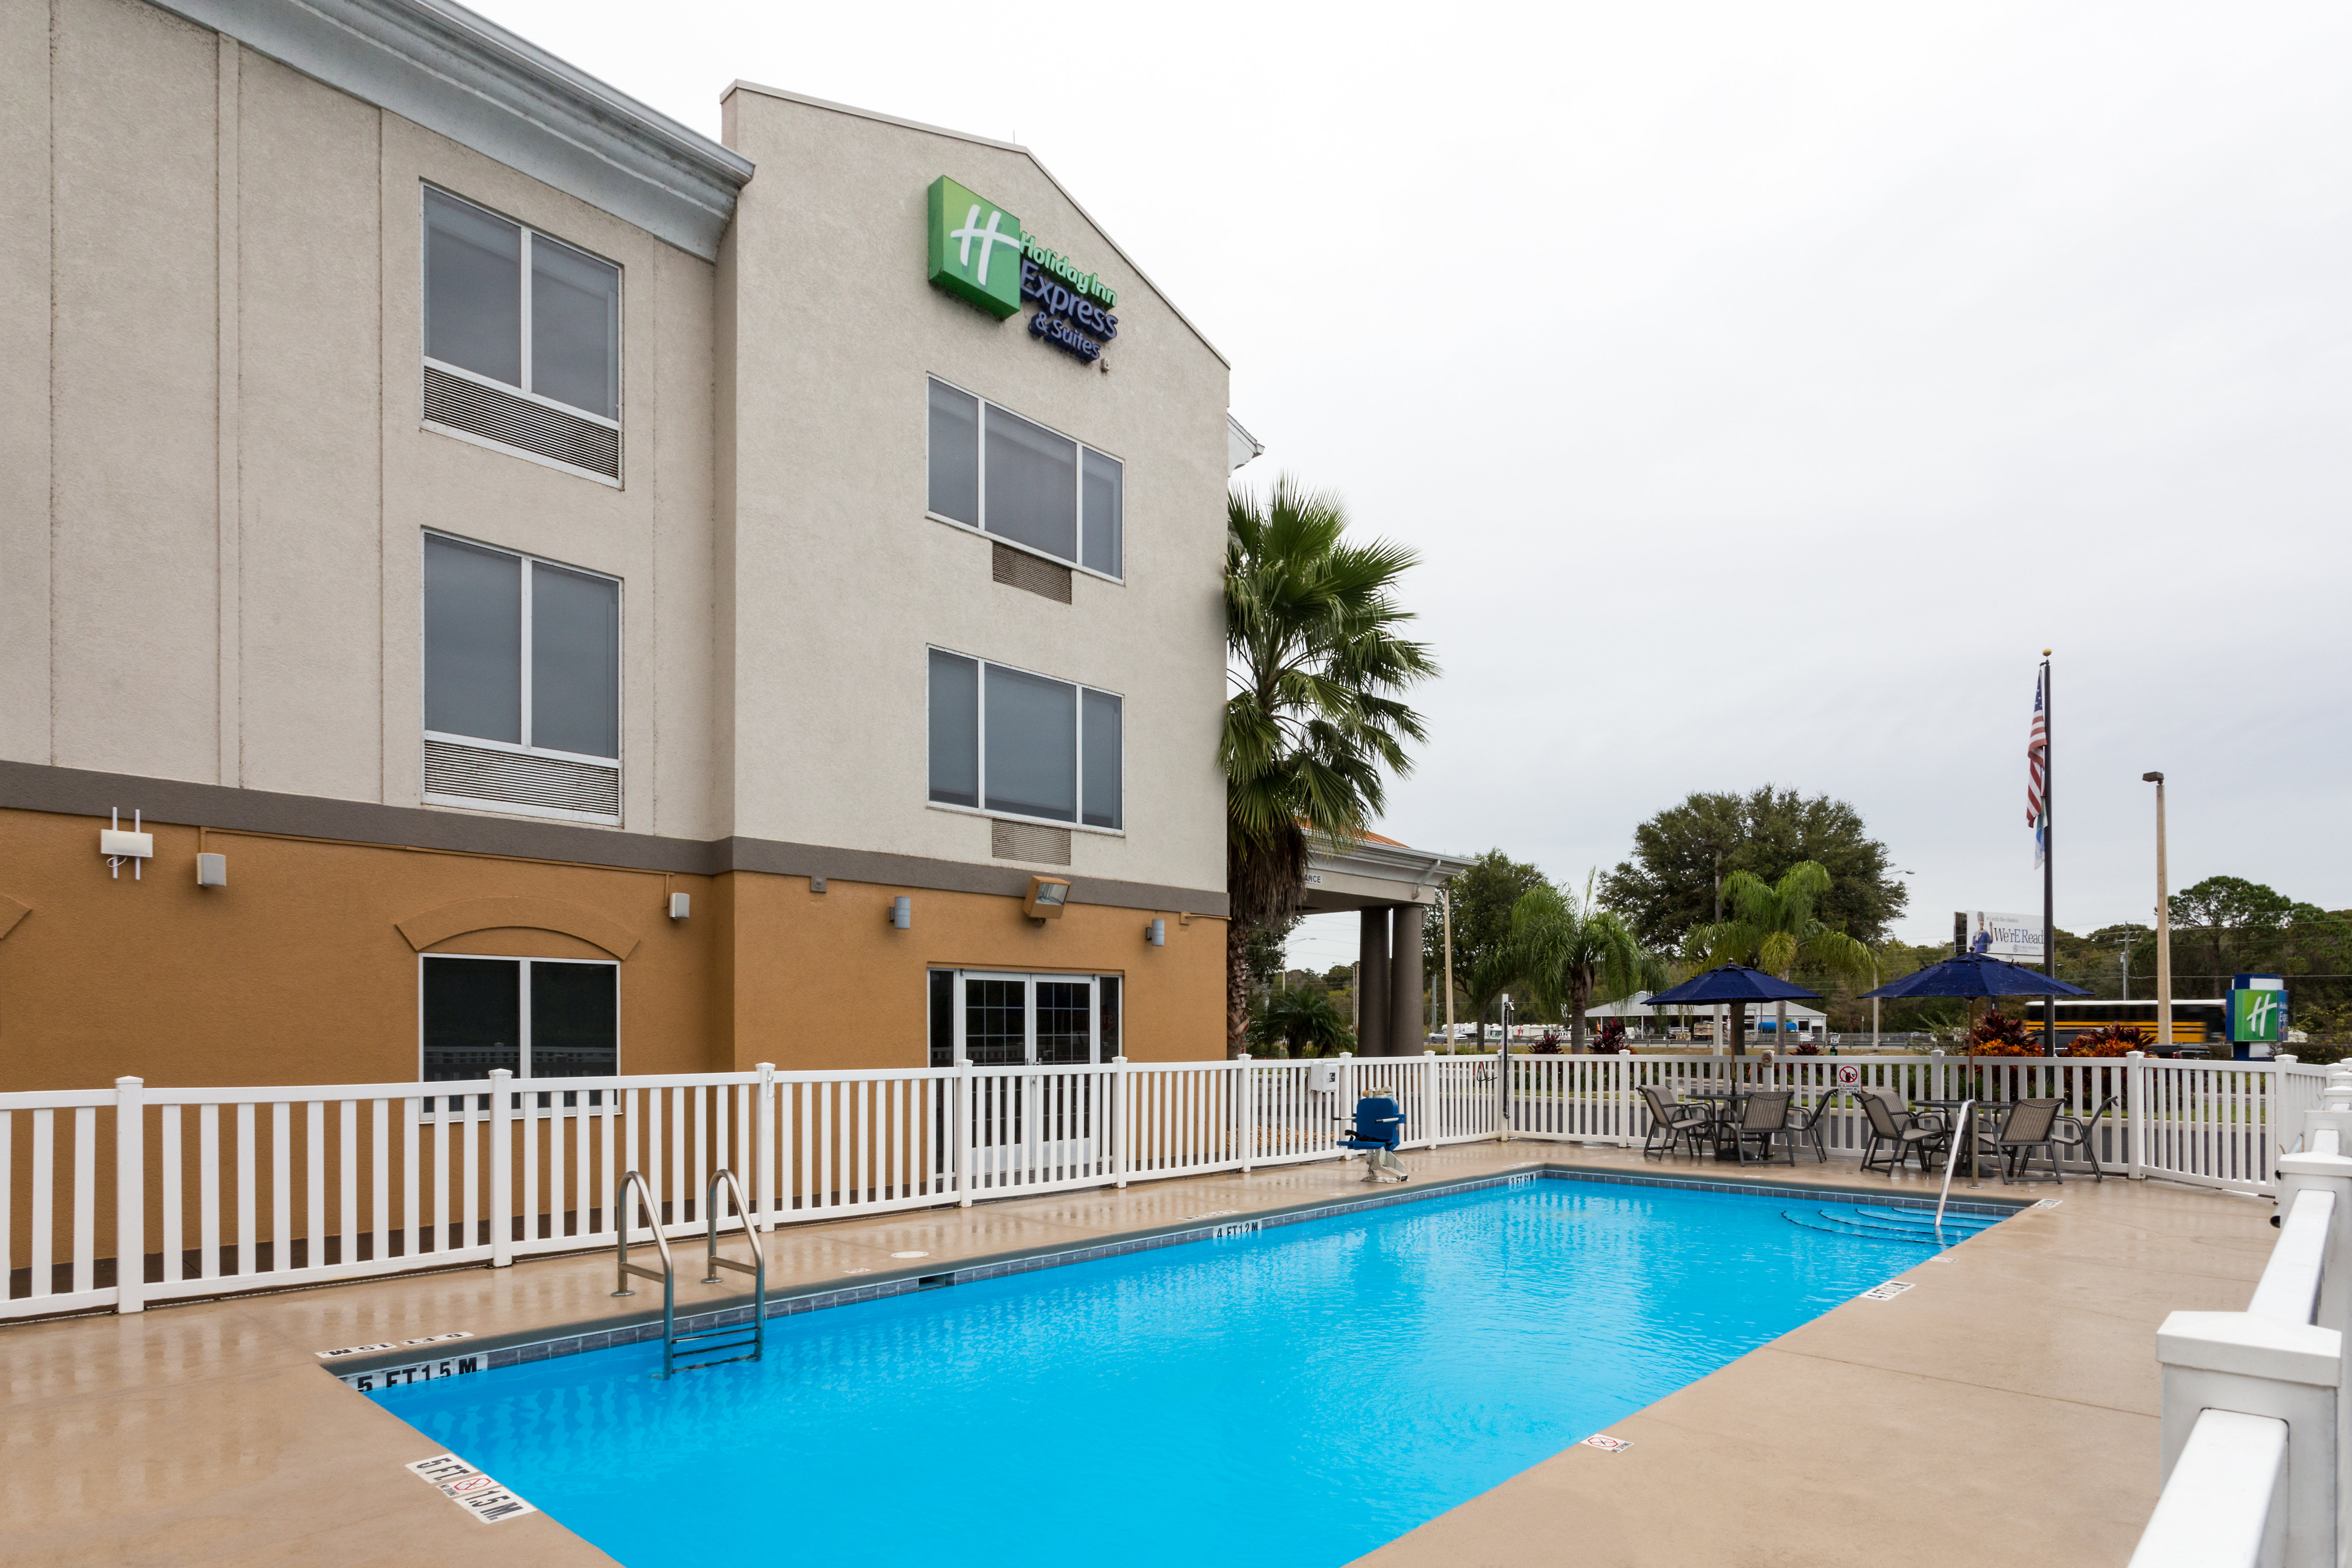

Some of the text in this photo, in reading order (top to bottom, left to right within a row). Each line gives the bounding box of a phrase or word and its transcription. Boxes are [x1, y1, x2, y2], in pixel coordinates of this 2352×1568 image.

[1020, 230, 1118, 307] Holiday Inn
[1020, 259, 1118, 339] Express
[1036, 311, 1100, 359] & Suites
[1305, 874, 1321, 883] ANCE
[2022, 929, 2044, 944] Read
[1217, 1228, 1222, 1237] 4
[1227, 1225, 1238, 1236] FT
[357, 1375, 373, 1392] 5
[416, 1457, 452, 1469] 5
[443, 1488, 459, 1496] DIVING
